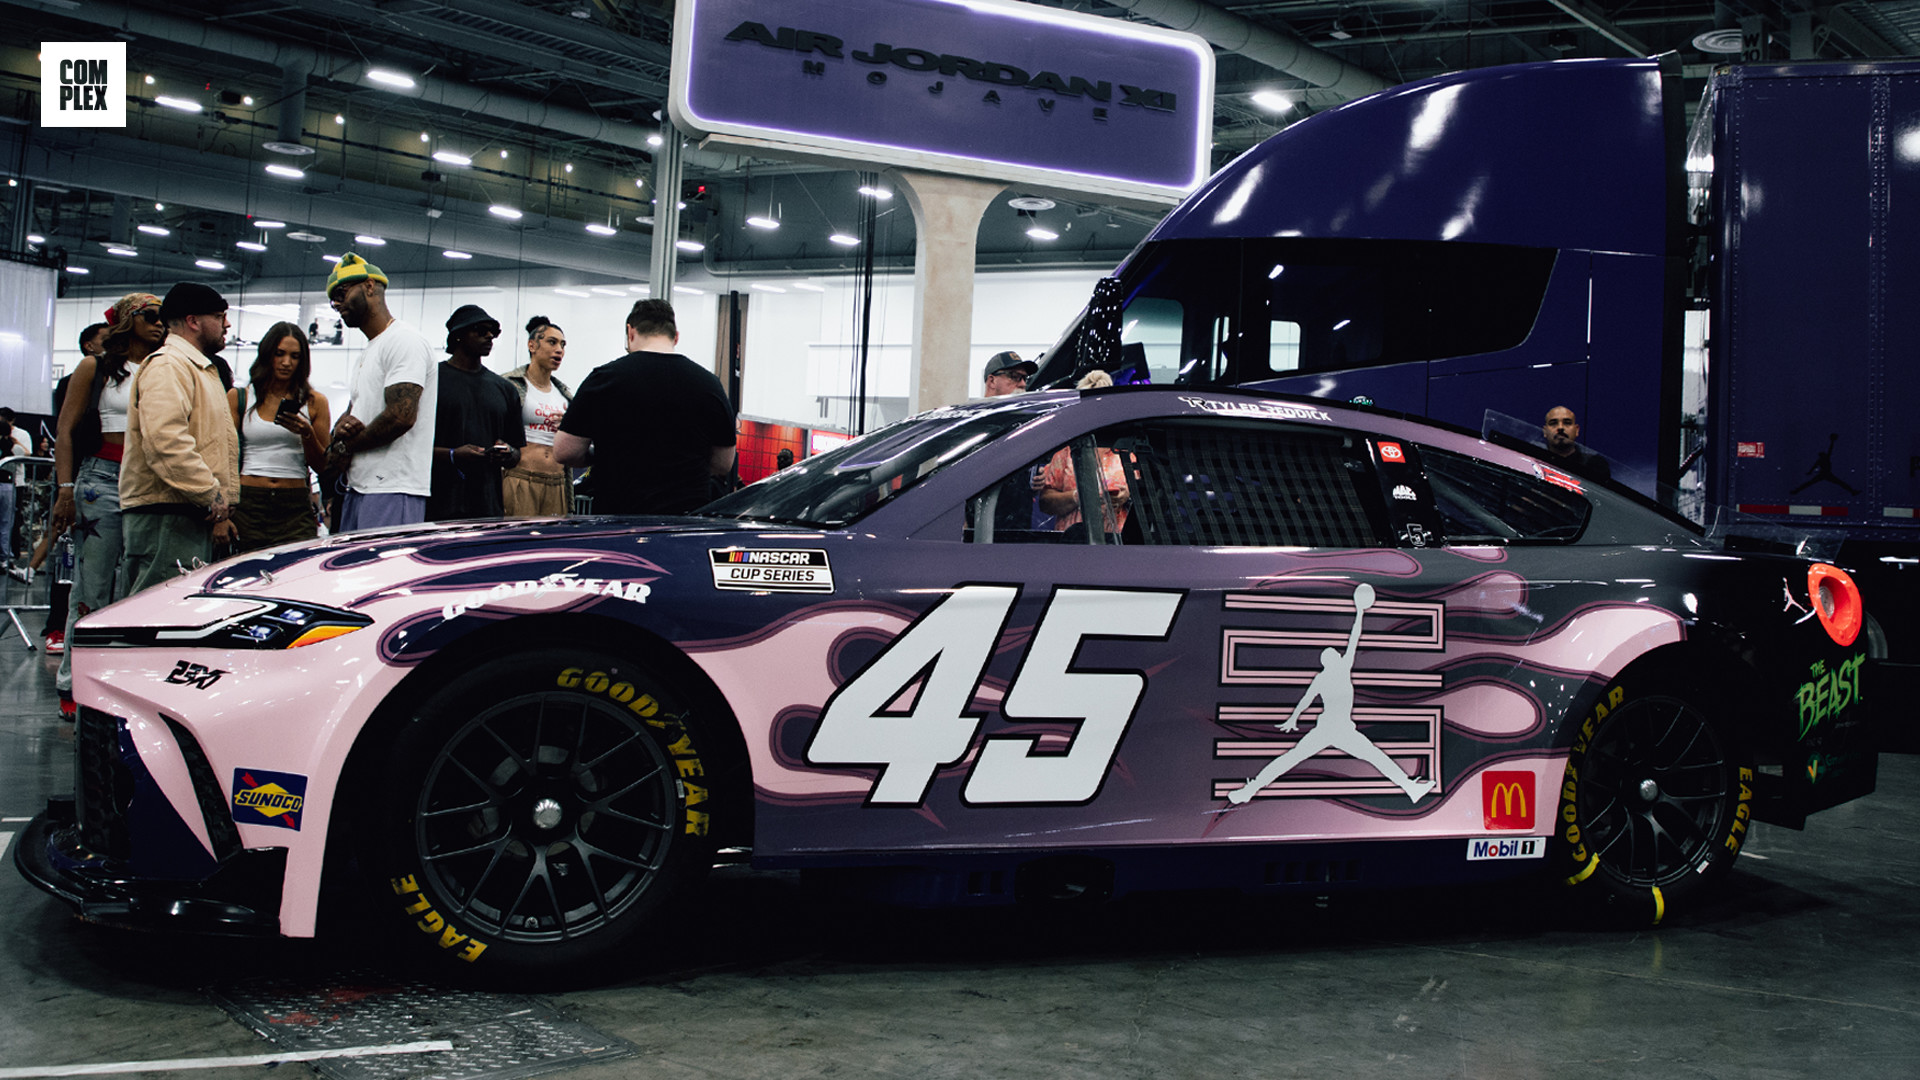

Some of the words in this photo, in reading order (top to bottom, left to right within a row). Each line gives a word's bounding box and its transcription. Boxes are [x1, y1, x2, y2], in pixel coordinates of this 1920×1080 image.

[724, 21, 844, 59] AIR
[852, 43, 1112, 103] JORDAN
[1118, 84, 1177, 113] XI
[748, 552, 810, 564] NASCAR
[731, 568, 761, 580] CUP
[763, 569, 815, 581] SERIES
[1810, 659, 1826, 678] THE
[802, 581, 1190, 808] 45
[237, 791, 301, 810] SUNOCO
[1724, 767, 1753, 855] EAGLE
[1473, 840, 1518, 857] Mobil
[391, 874, 488, 963] EAGLE
